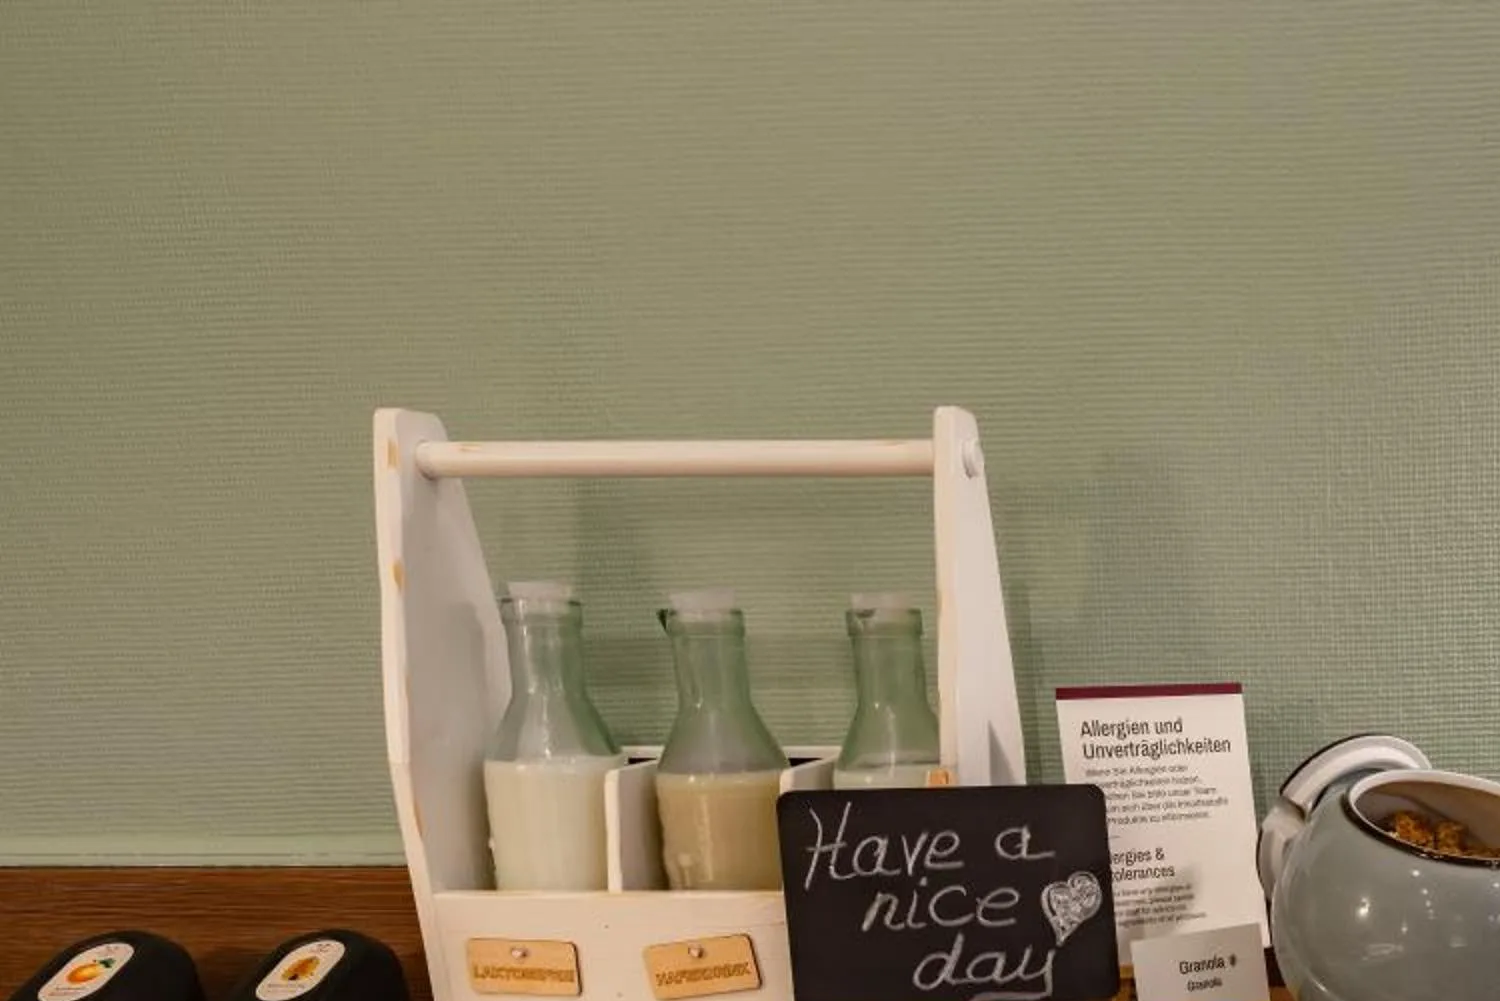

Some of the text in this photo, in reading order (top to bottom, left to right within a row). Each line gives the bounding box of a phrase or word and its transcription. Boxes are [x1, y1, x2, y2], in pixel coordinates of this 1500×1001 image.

[1080, 716, 1184, 740] Allergien und
[1082, 736, 1232, 761] Unverträglichkeiten
[803, 800, 1056, 891] Have a
[1111, 847, 1166, 866] ergies &
[1111, 865, 1175, 881] olerances
[861, 876, 1021, 933] nice
[1178, 954, 1226, 975] Granola
